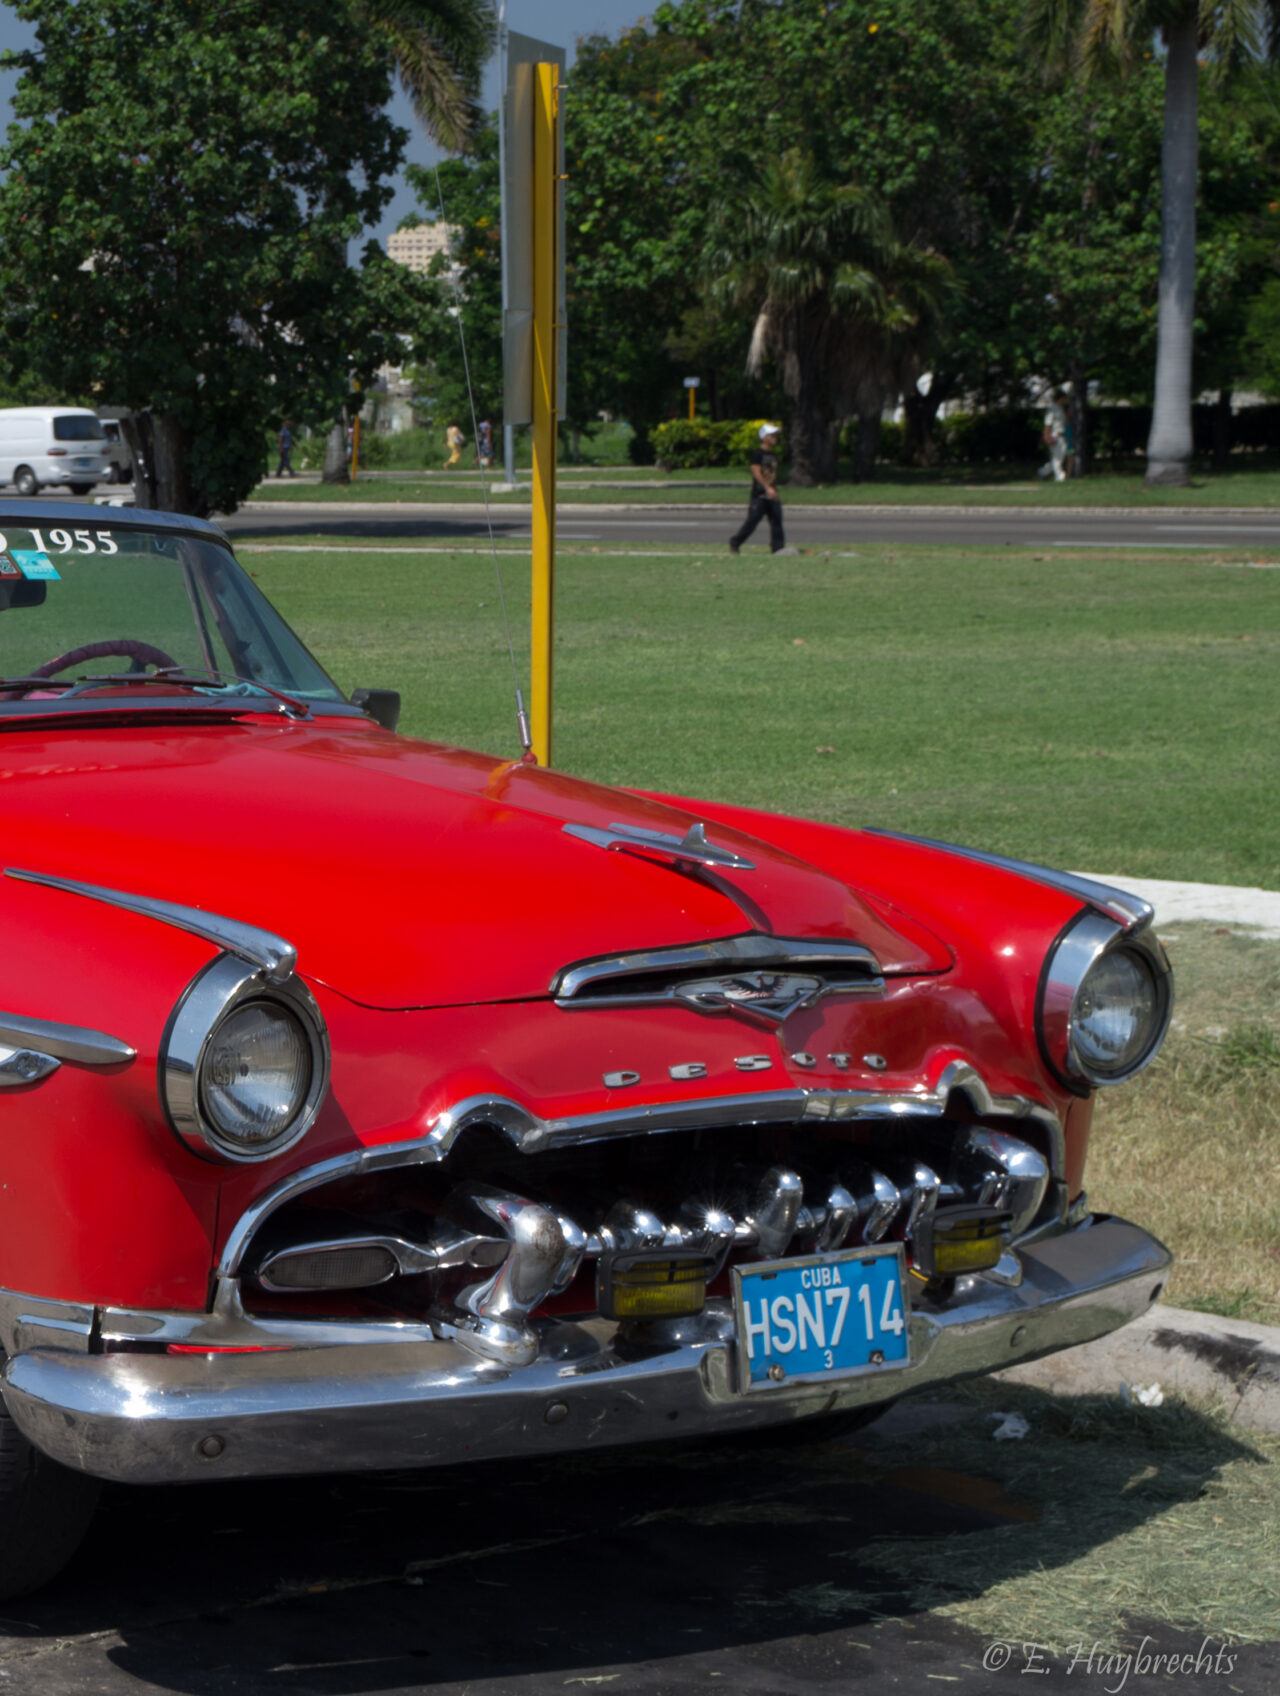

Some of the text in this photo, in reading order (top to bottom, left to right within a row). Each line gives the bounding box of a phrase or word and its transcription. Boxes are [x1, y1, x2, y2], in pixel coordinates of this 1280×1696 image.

[29, 528, 119, 555] 1955
[801, 1266, 842, 1289] CUBA
[743, 1280, 905, 1359] HSN714
[824, 1350, 834, 1369] 3
